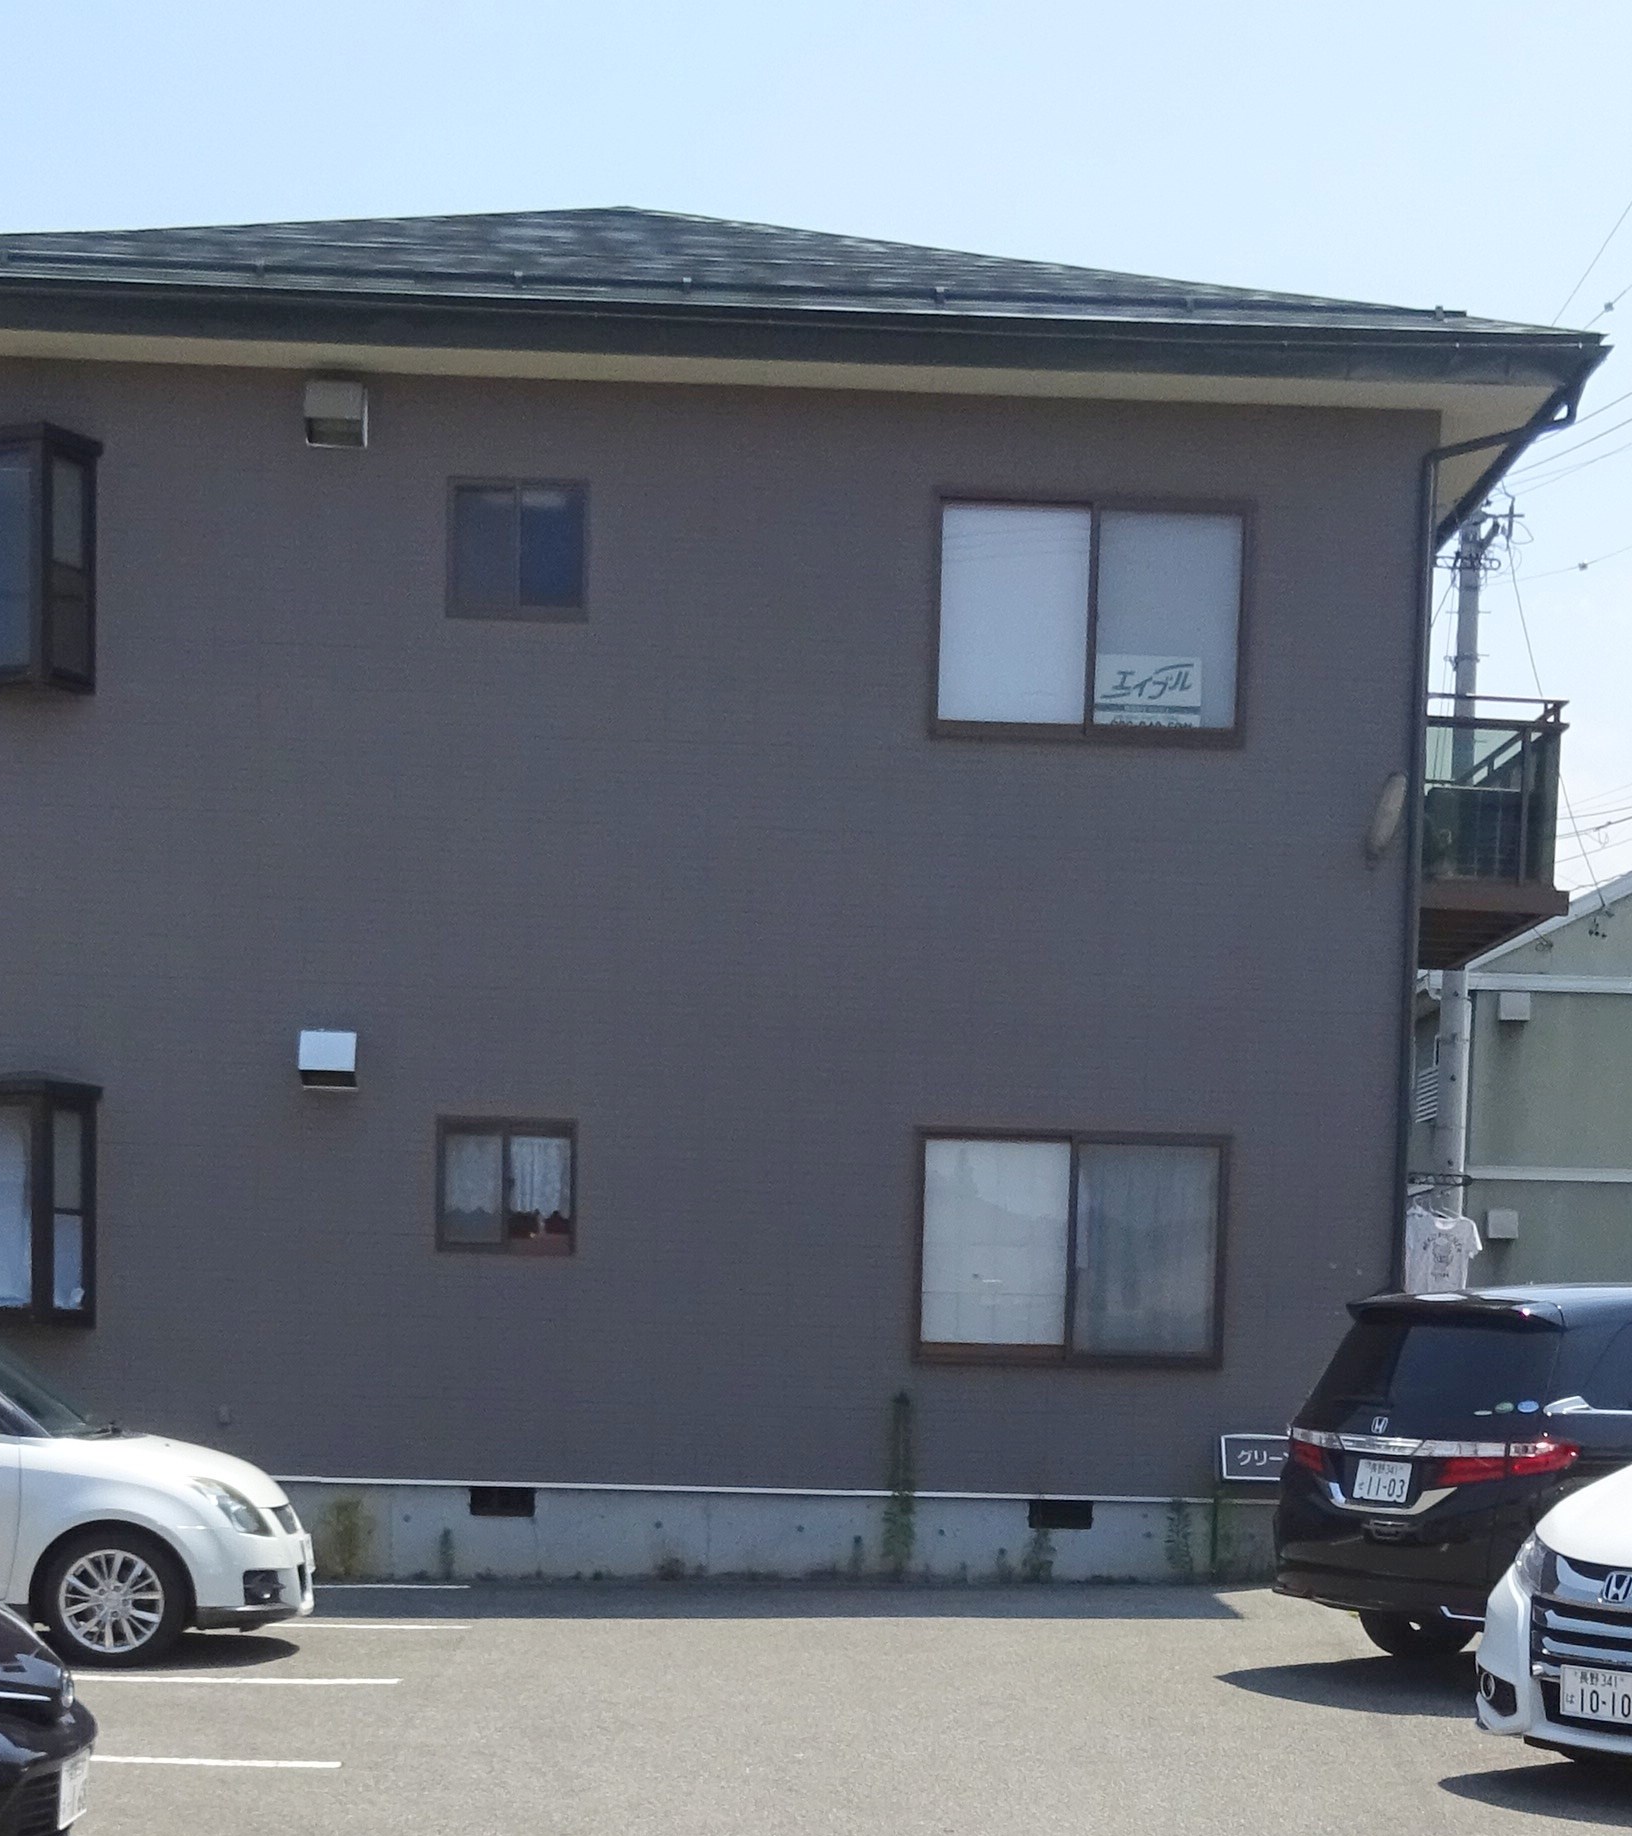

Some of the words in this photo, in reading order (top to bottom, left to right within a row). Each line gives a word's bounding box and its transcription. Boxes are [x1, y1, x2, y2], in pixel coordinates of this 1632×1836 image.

[1100, 663, 1195, 700] エイブル
[1237, 1449, 1289, 1466] グリー
[1367, 1476, 1405, 1498] 11-03
[1581, 1688, 1631, 1718] 10-10
